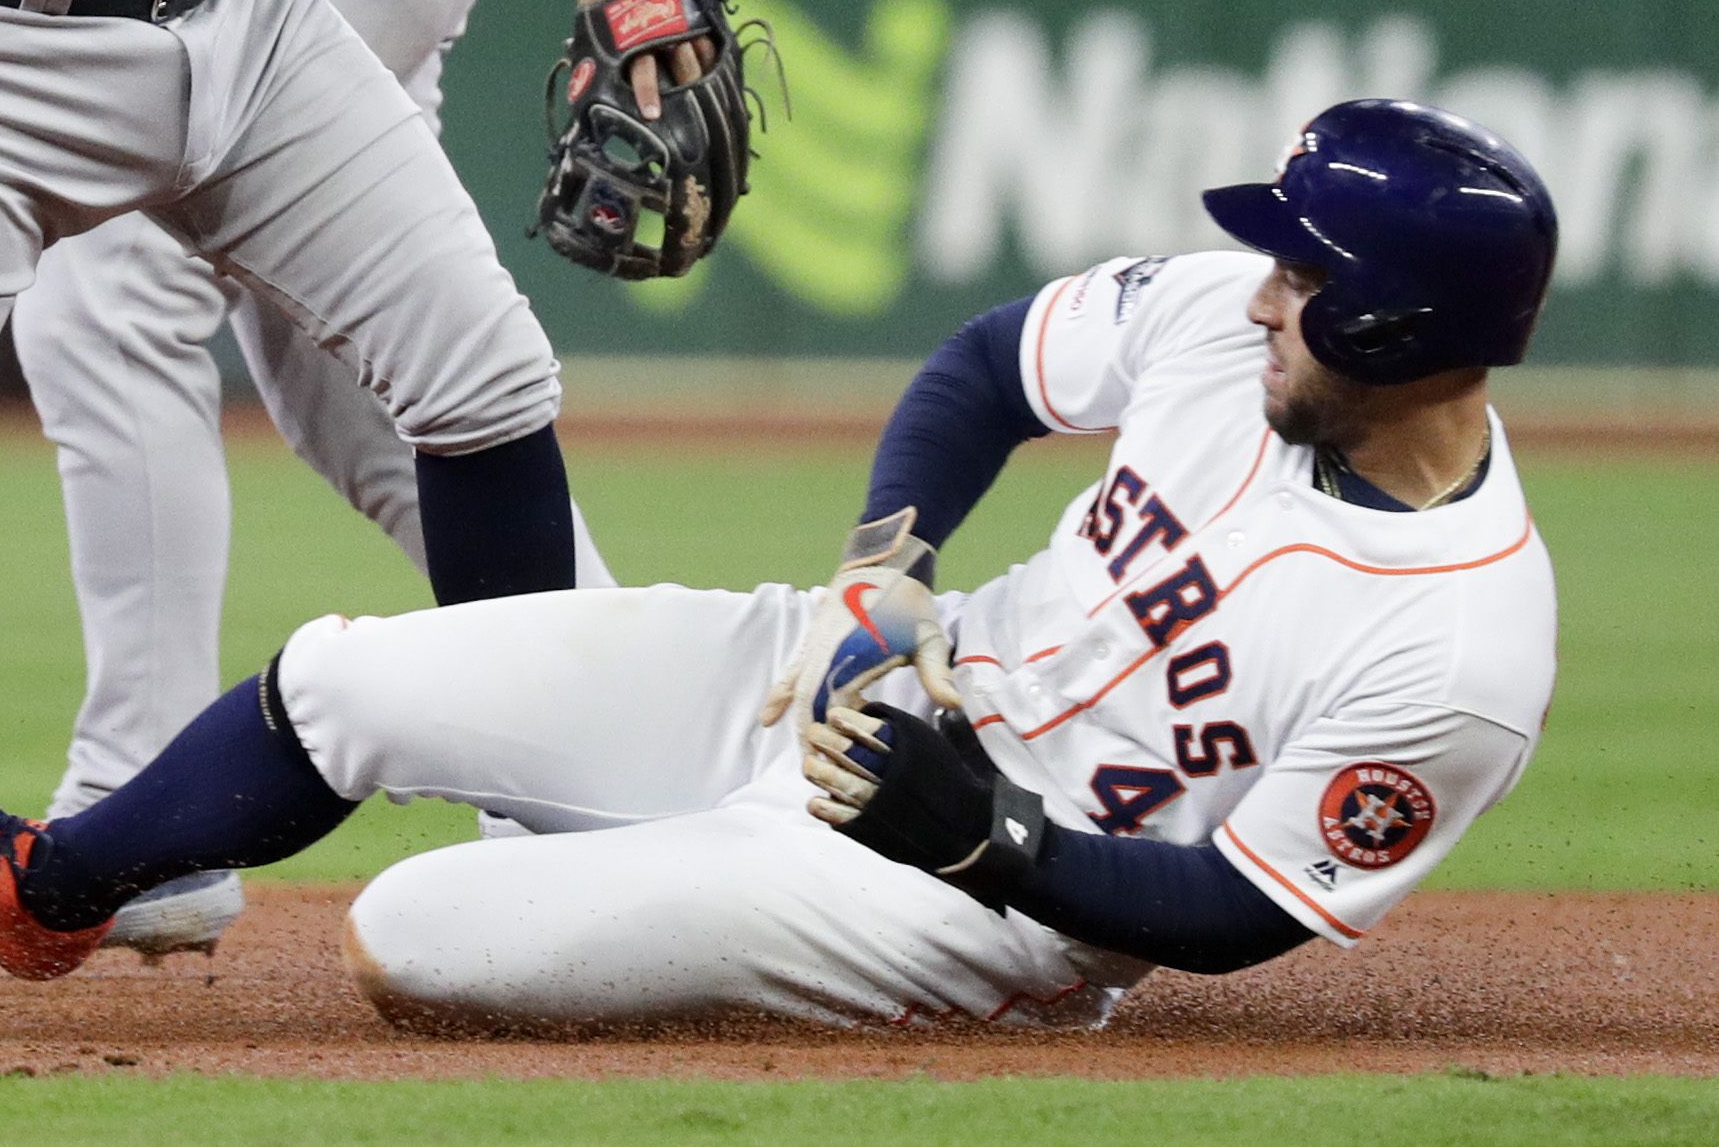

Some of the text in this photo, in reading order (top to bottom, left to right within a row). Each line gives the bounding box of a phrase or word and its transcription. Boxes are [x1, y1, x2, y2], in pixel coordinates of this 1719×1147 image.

[1084, 763, 1187, 837] 4
[1355, 768, 1432, 821] HOUSTON
[1005, 817, 1029, 845] 4
[1323, 815, 1391, 864] ASTROS
